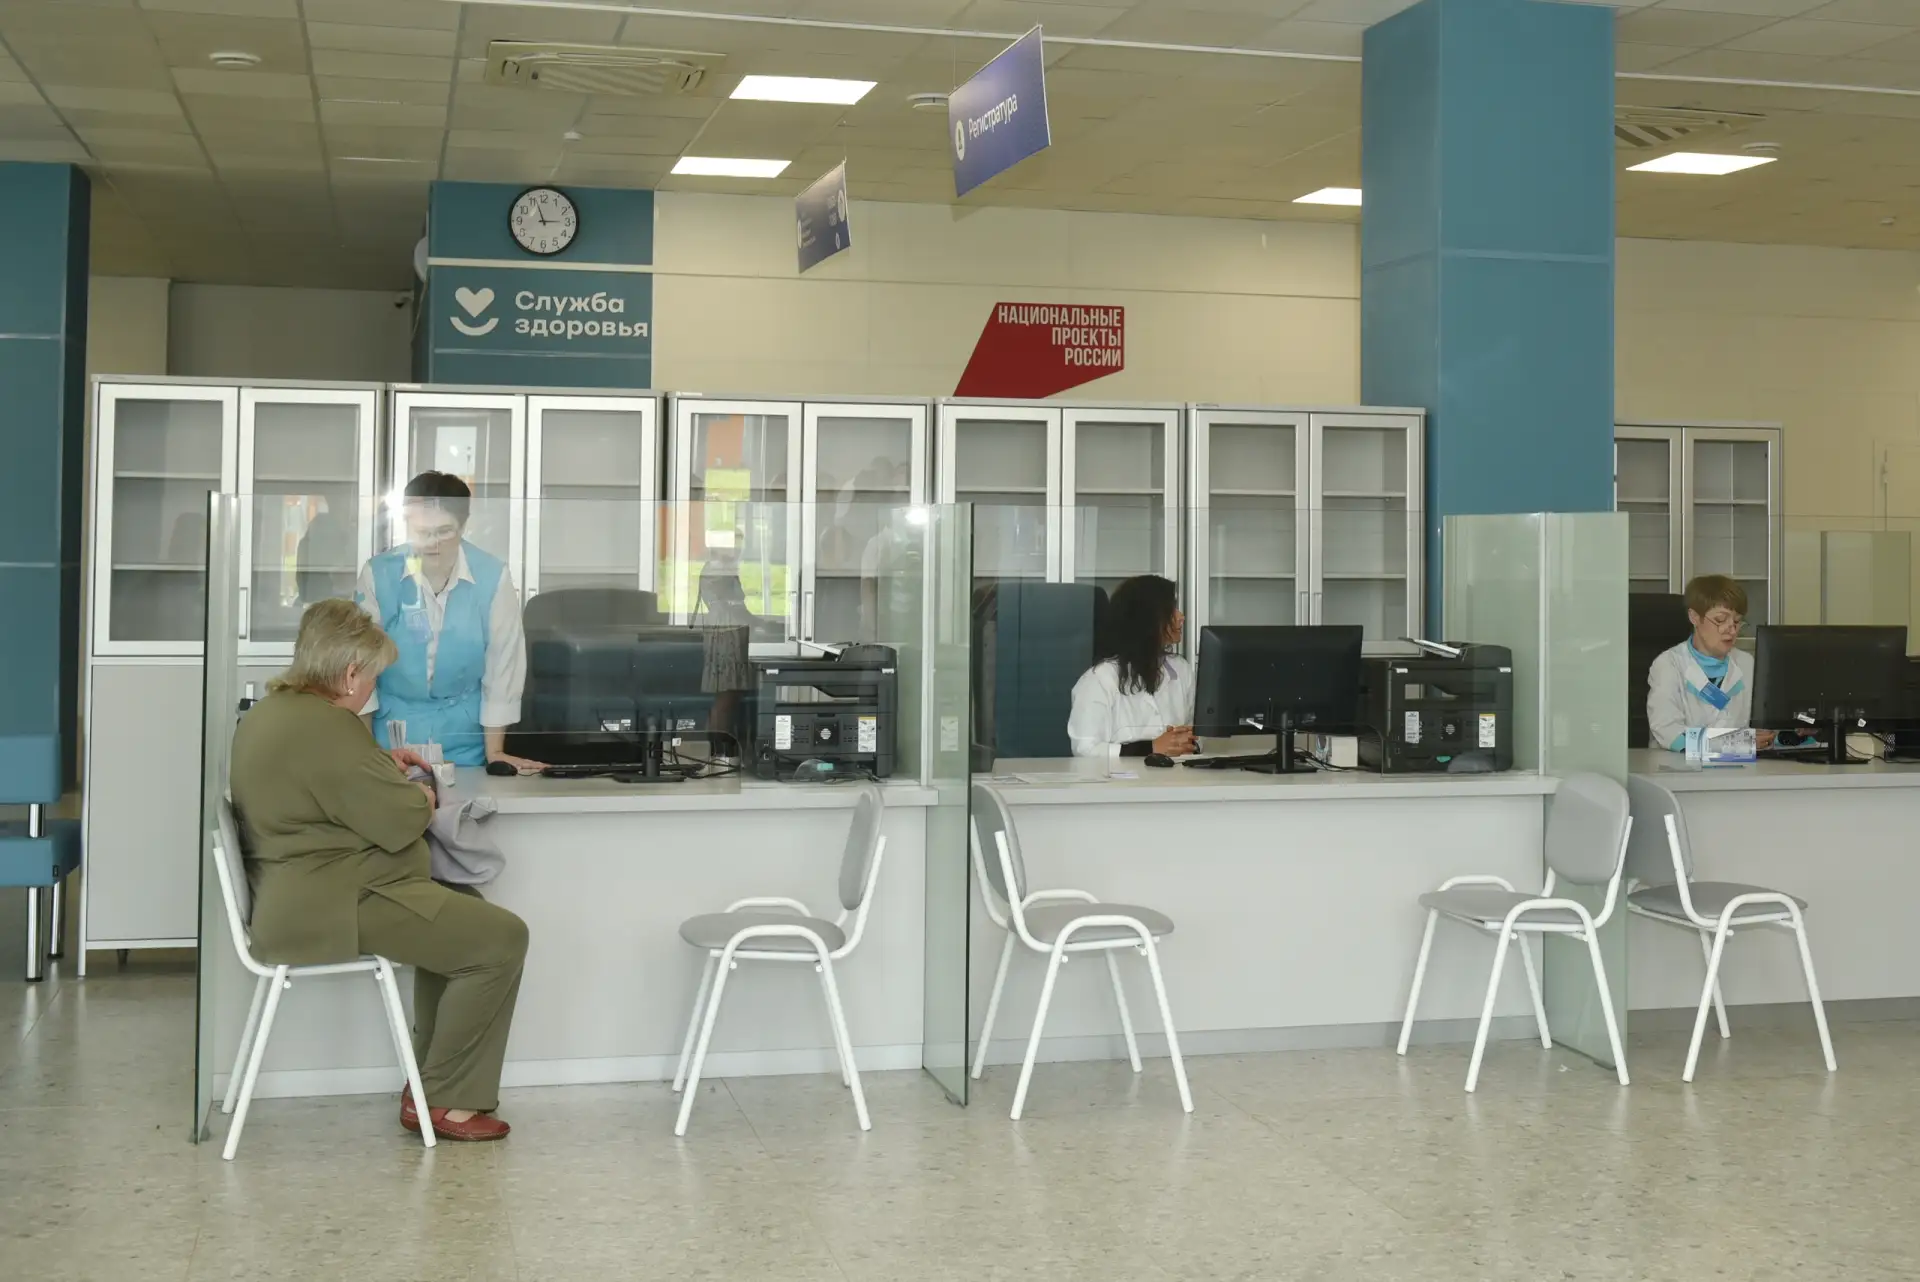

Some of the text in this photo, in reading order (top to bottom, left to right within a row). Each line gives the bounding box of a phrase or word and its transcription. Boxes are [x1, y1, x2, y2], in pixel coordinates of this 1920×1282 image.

[968, 93, 1018, 140] Регистратура
[515, 290, 625, 316] Служба
[998, 305, 1122, 327] НАЦИОНАЛЬНЫЕ
[515, 318, 648, 340] здоровья
[1052, 327, 1122, 346] ПРОЕКТЫ
[1064, 347, 1122, 367] РОССИИ
